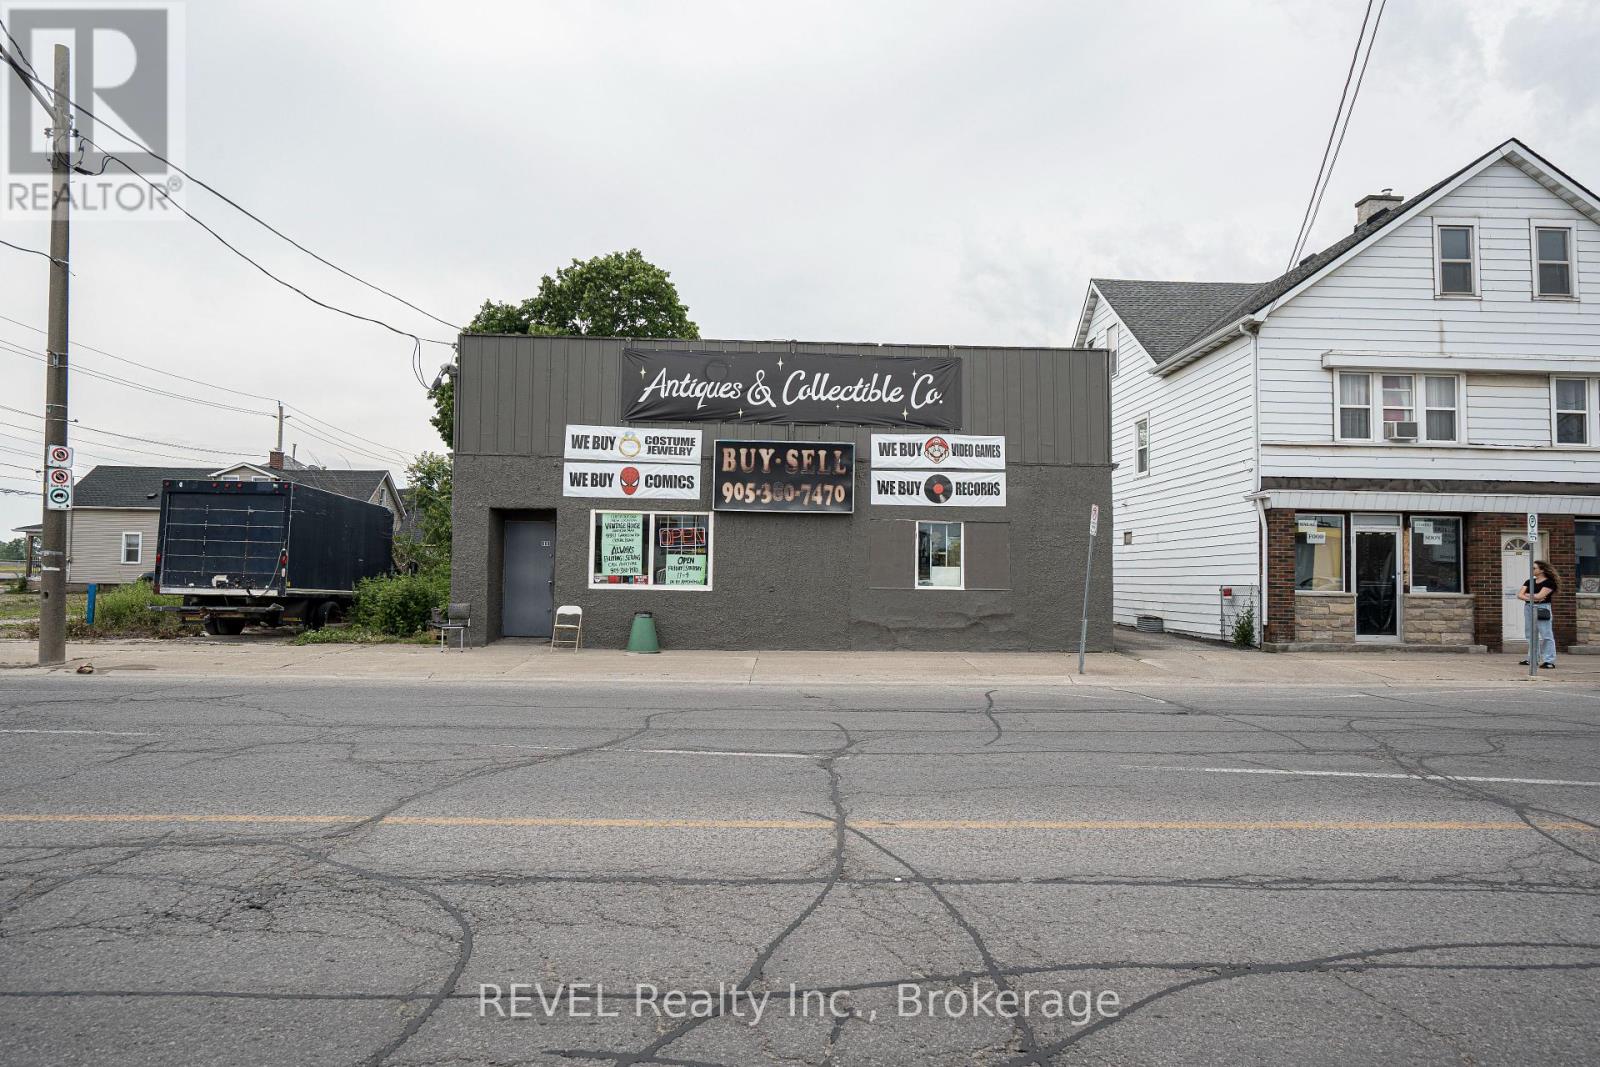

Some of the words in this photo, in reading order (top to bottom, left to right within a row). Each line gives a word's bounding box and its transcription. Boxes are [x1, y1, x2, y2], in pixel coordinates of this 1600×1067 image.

[638, 367, 742, 410] Antiques
[747, 369, 777, 408] &
[782, 369, 904, 406] Collectible
[910, 373, 944, 409] Co.
[571, 434, 590, 450] WE
[592, 435, 616, 451] BUY
[644, 435, 696, 447] COSTUME
[646, 446, 693, 456] JEWELRY
[878, 442, 897, 457] WE
[899, 442, 923, 457] BUY
[951, 443, 973, 457] VIDEO
[974, 443, 1001, 458] GAMES
[569, 471, 589, 488] WE
[591, 472, 615, 488] BUY
[644, 474, 695, 489] COMICS
[877, 480, 896, 495] WE
[898, 480, 922, 496] BUY
[955, 481, 1001, 497] RECORDS
[660, 528, 705, 546] OPEN
[677, 556, 695, 565] OPEN
